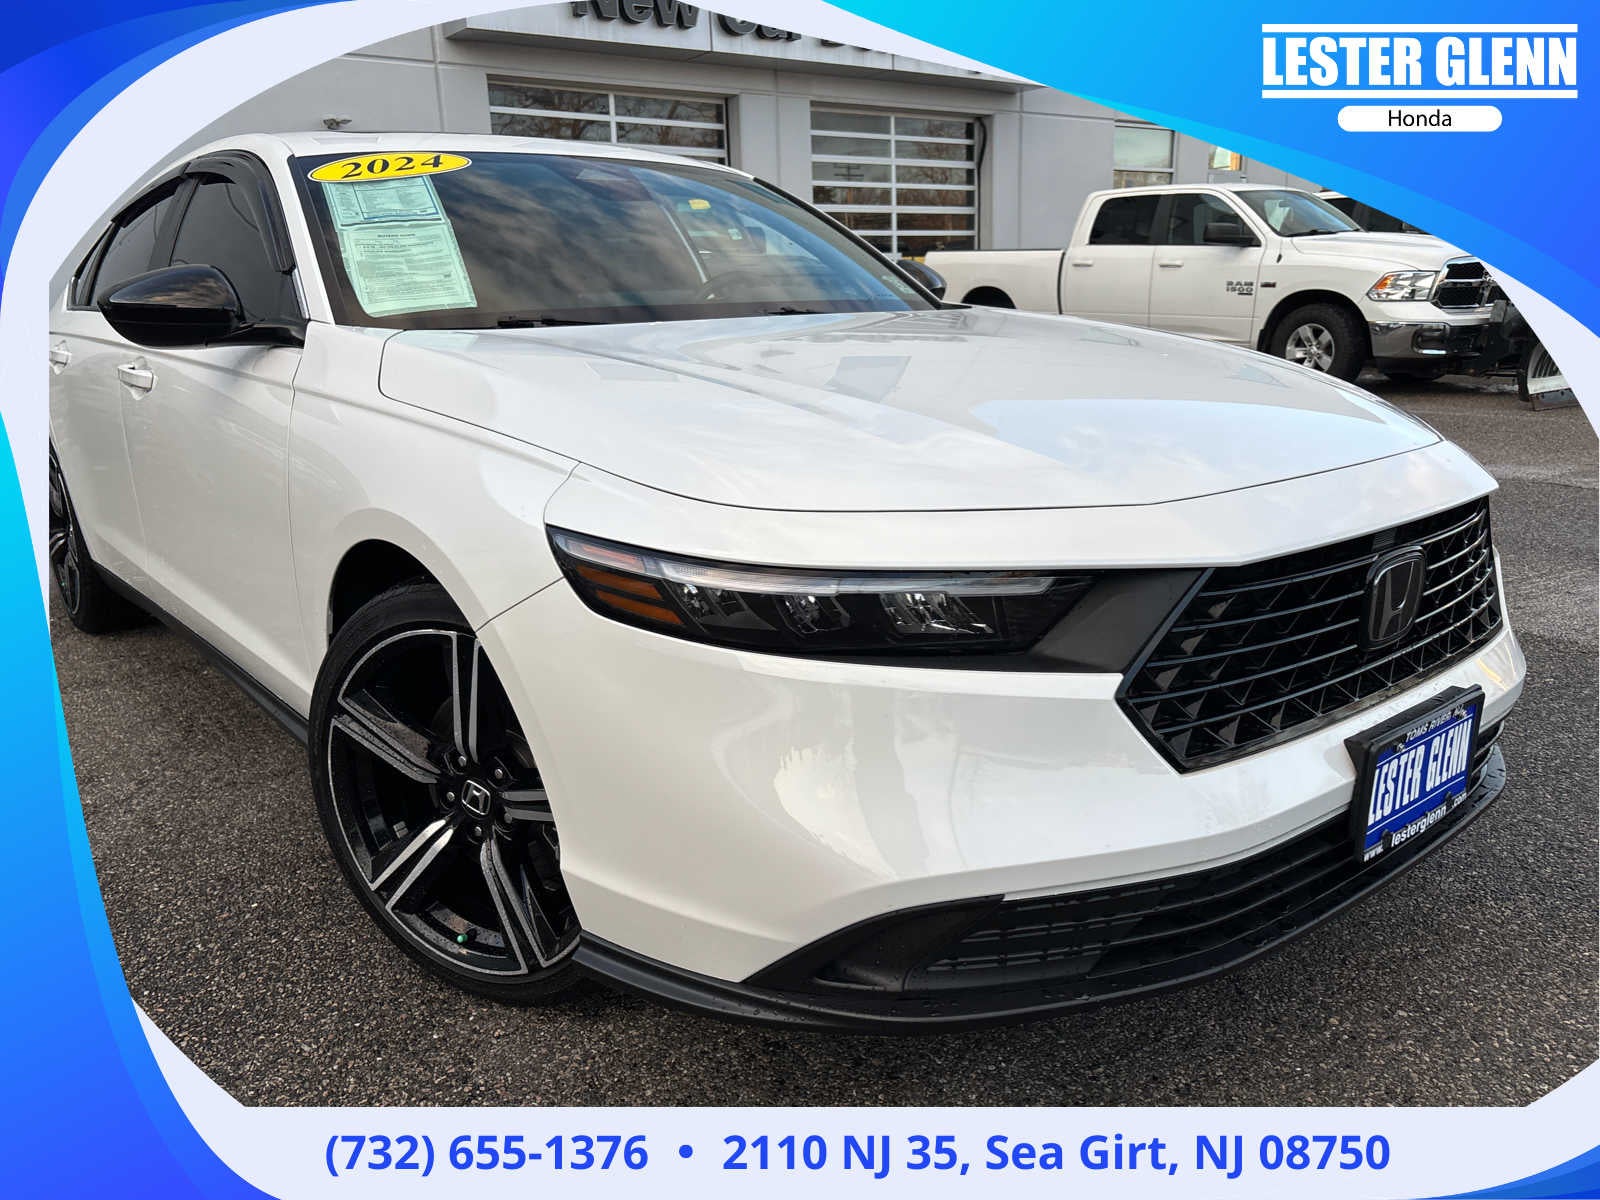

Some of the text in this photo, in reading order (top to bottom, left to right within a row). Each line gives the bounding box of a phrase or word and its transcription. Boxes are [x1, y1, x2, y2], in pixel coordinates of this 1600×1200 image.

[341, 154, 443, 179] 2024
[1368, 719, 1472, 827] LESTER GLENN
